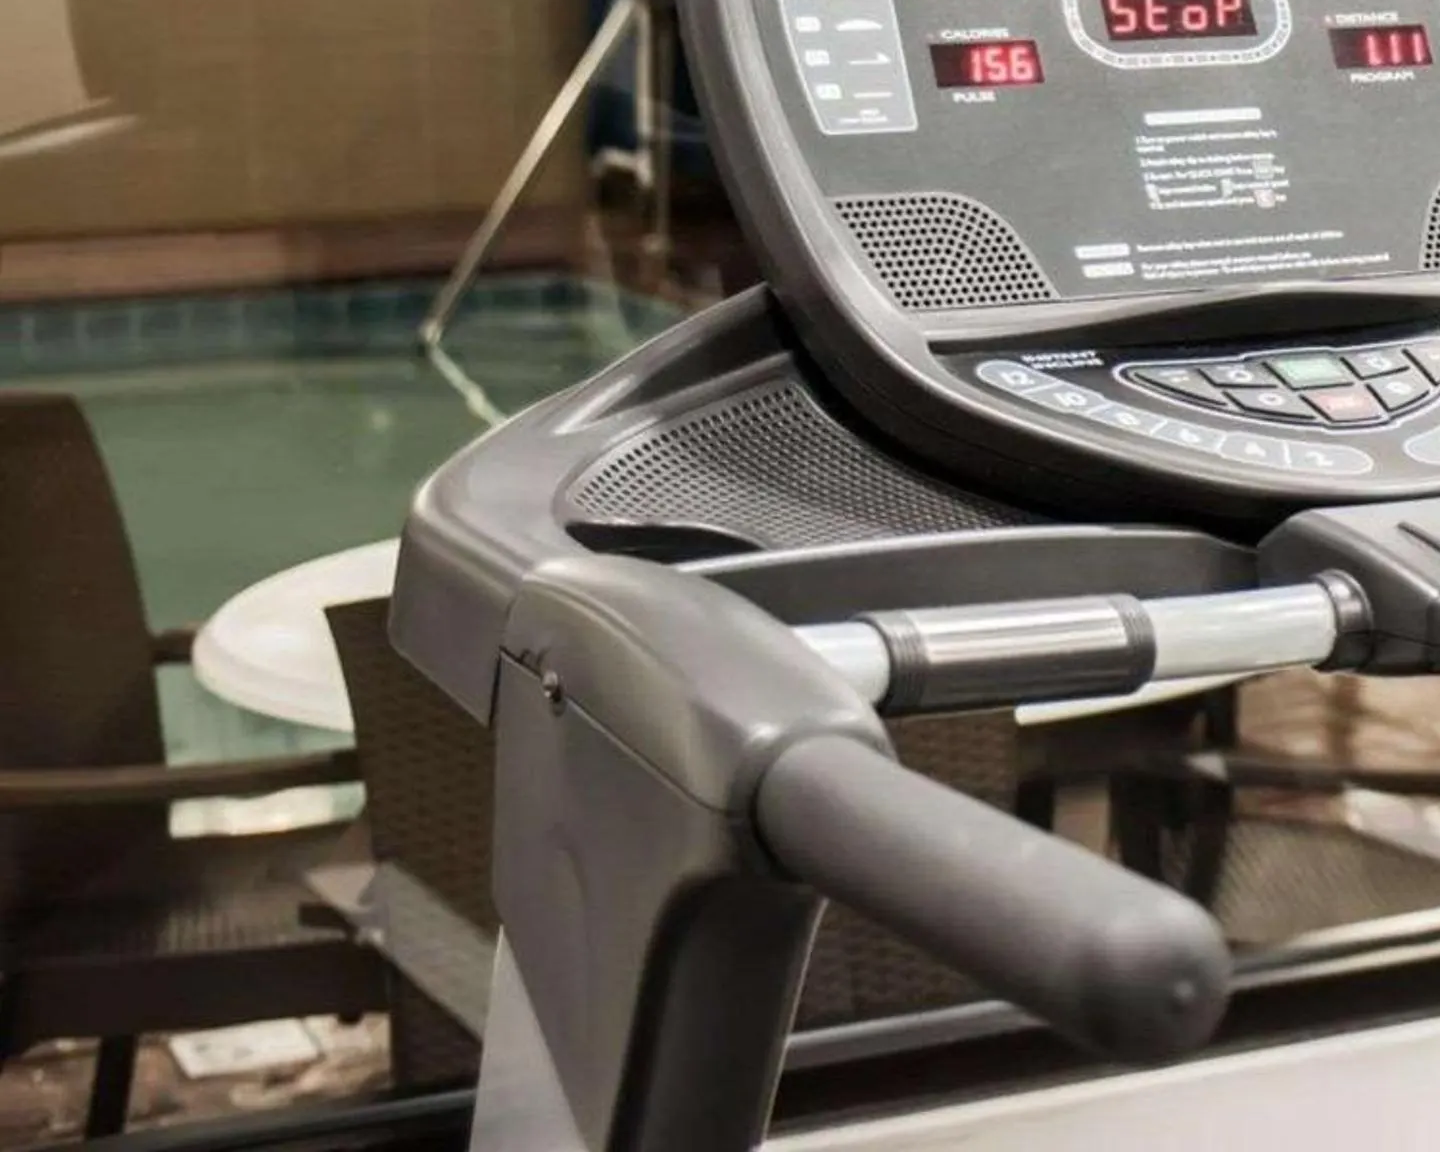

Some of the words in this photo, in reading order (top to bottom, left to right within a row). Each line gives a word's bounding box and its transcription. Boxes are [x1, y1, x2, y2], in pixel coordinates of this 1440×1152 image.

[1335, 11, 1399, 25] DISTANCE
[970, 46, 1034, 82] 156
[1350, 70, 1415, 83] PROGRAM
[952, 90, 996, 103] PULSE
[1000, 369, 1035, 386] 12
[1053, 391, 1088, 407] 10
[1305, 451, 1334, 466] 2
